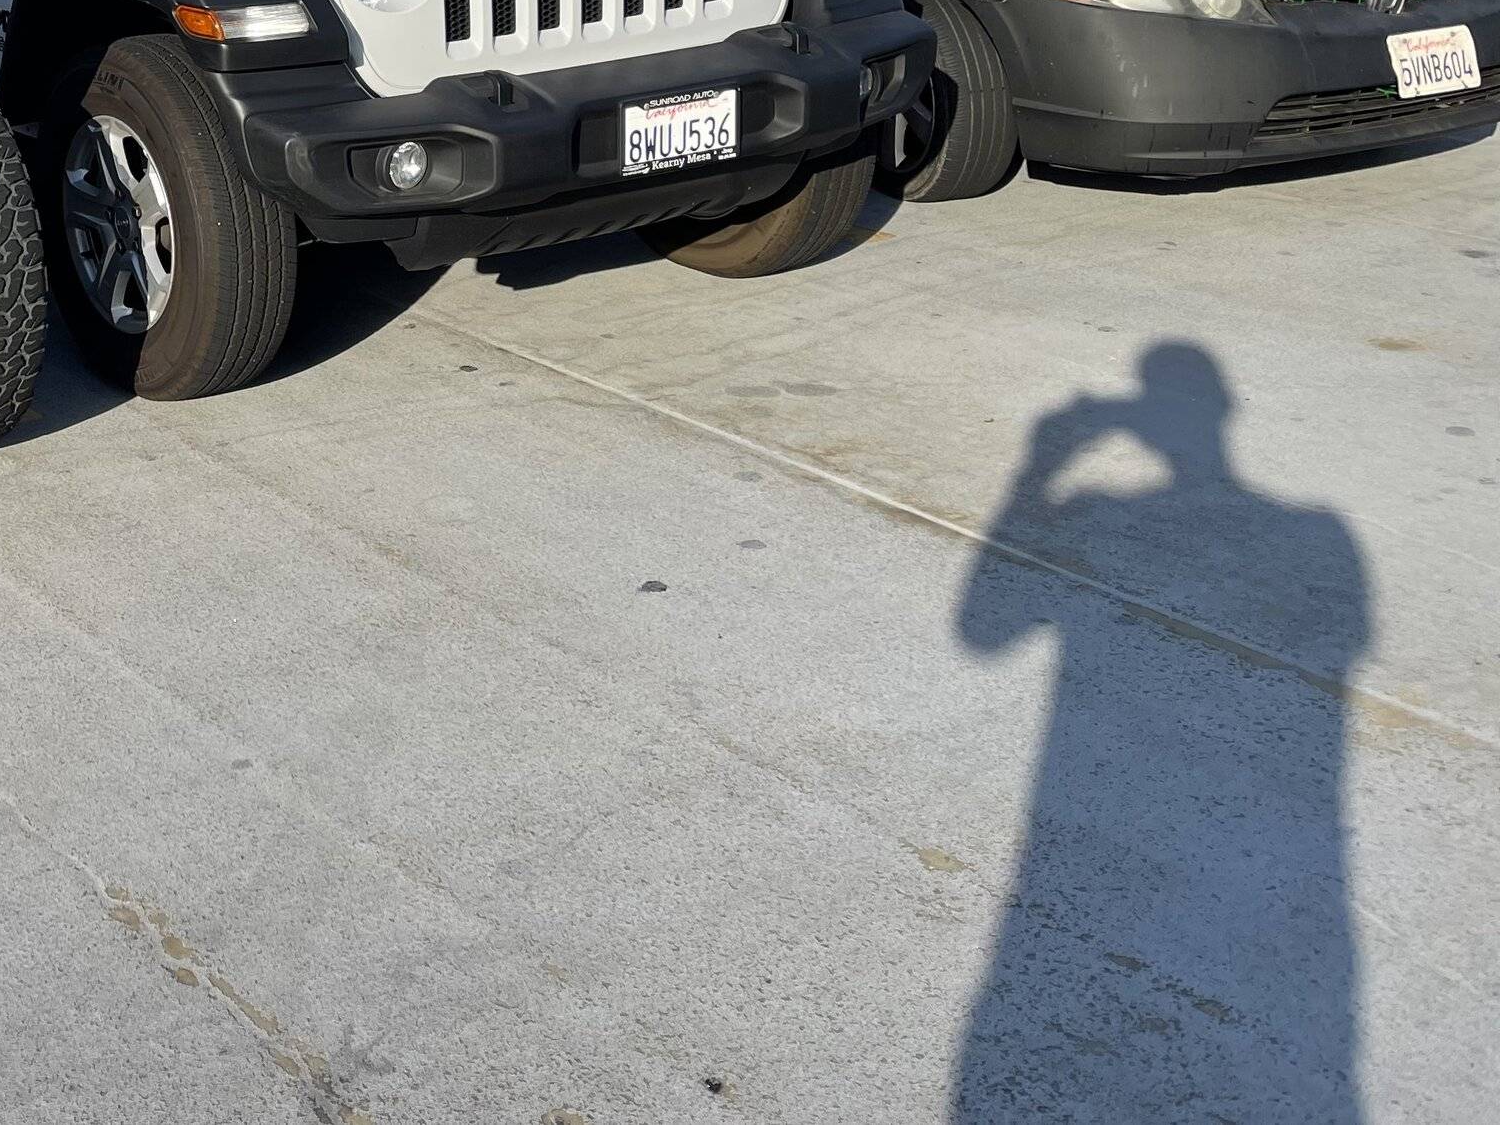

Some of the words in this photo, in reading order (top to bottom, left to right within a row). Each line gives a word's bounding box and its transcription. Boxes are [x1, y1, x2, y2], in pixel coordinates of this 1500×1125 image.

[1406, 34, 1455, 54] California
[1399, 49, 1474, 87] 5VNB604
[649, 94, 691, 107] SUNROAD
[693, 90, 714, 100] AUTO
[629, 112, 731, 163] 8WUJ536
[651, 158, 687, 171] Kearny
[687, 152, 712, 164] Mesa
